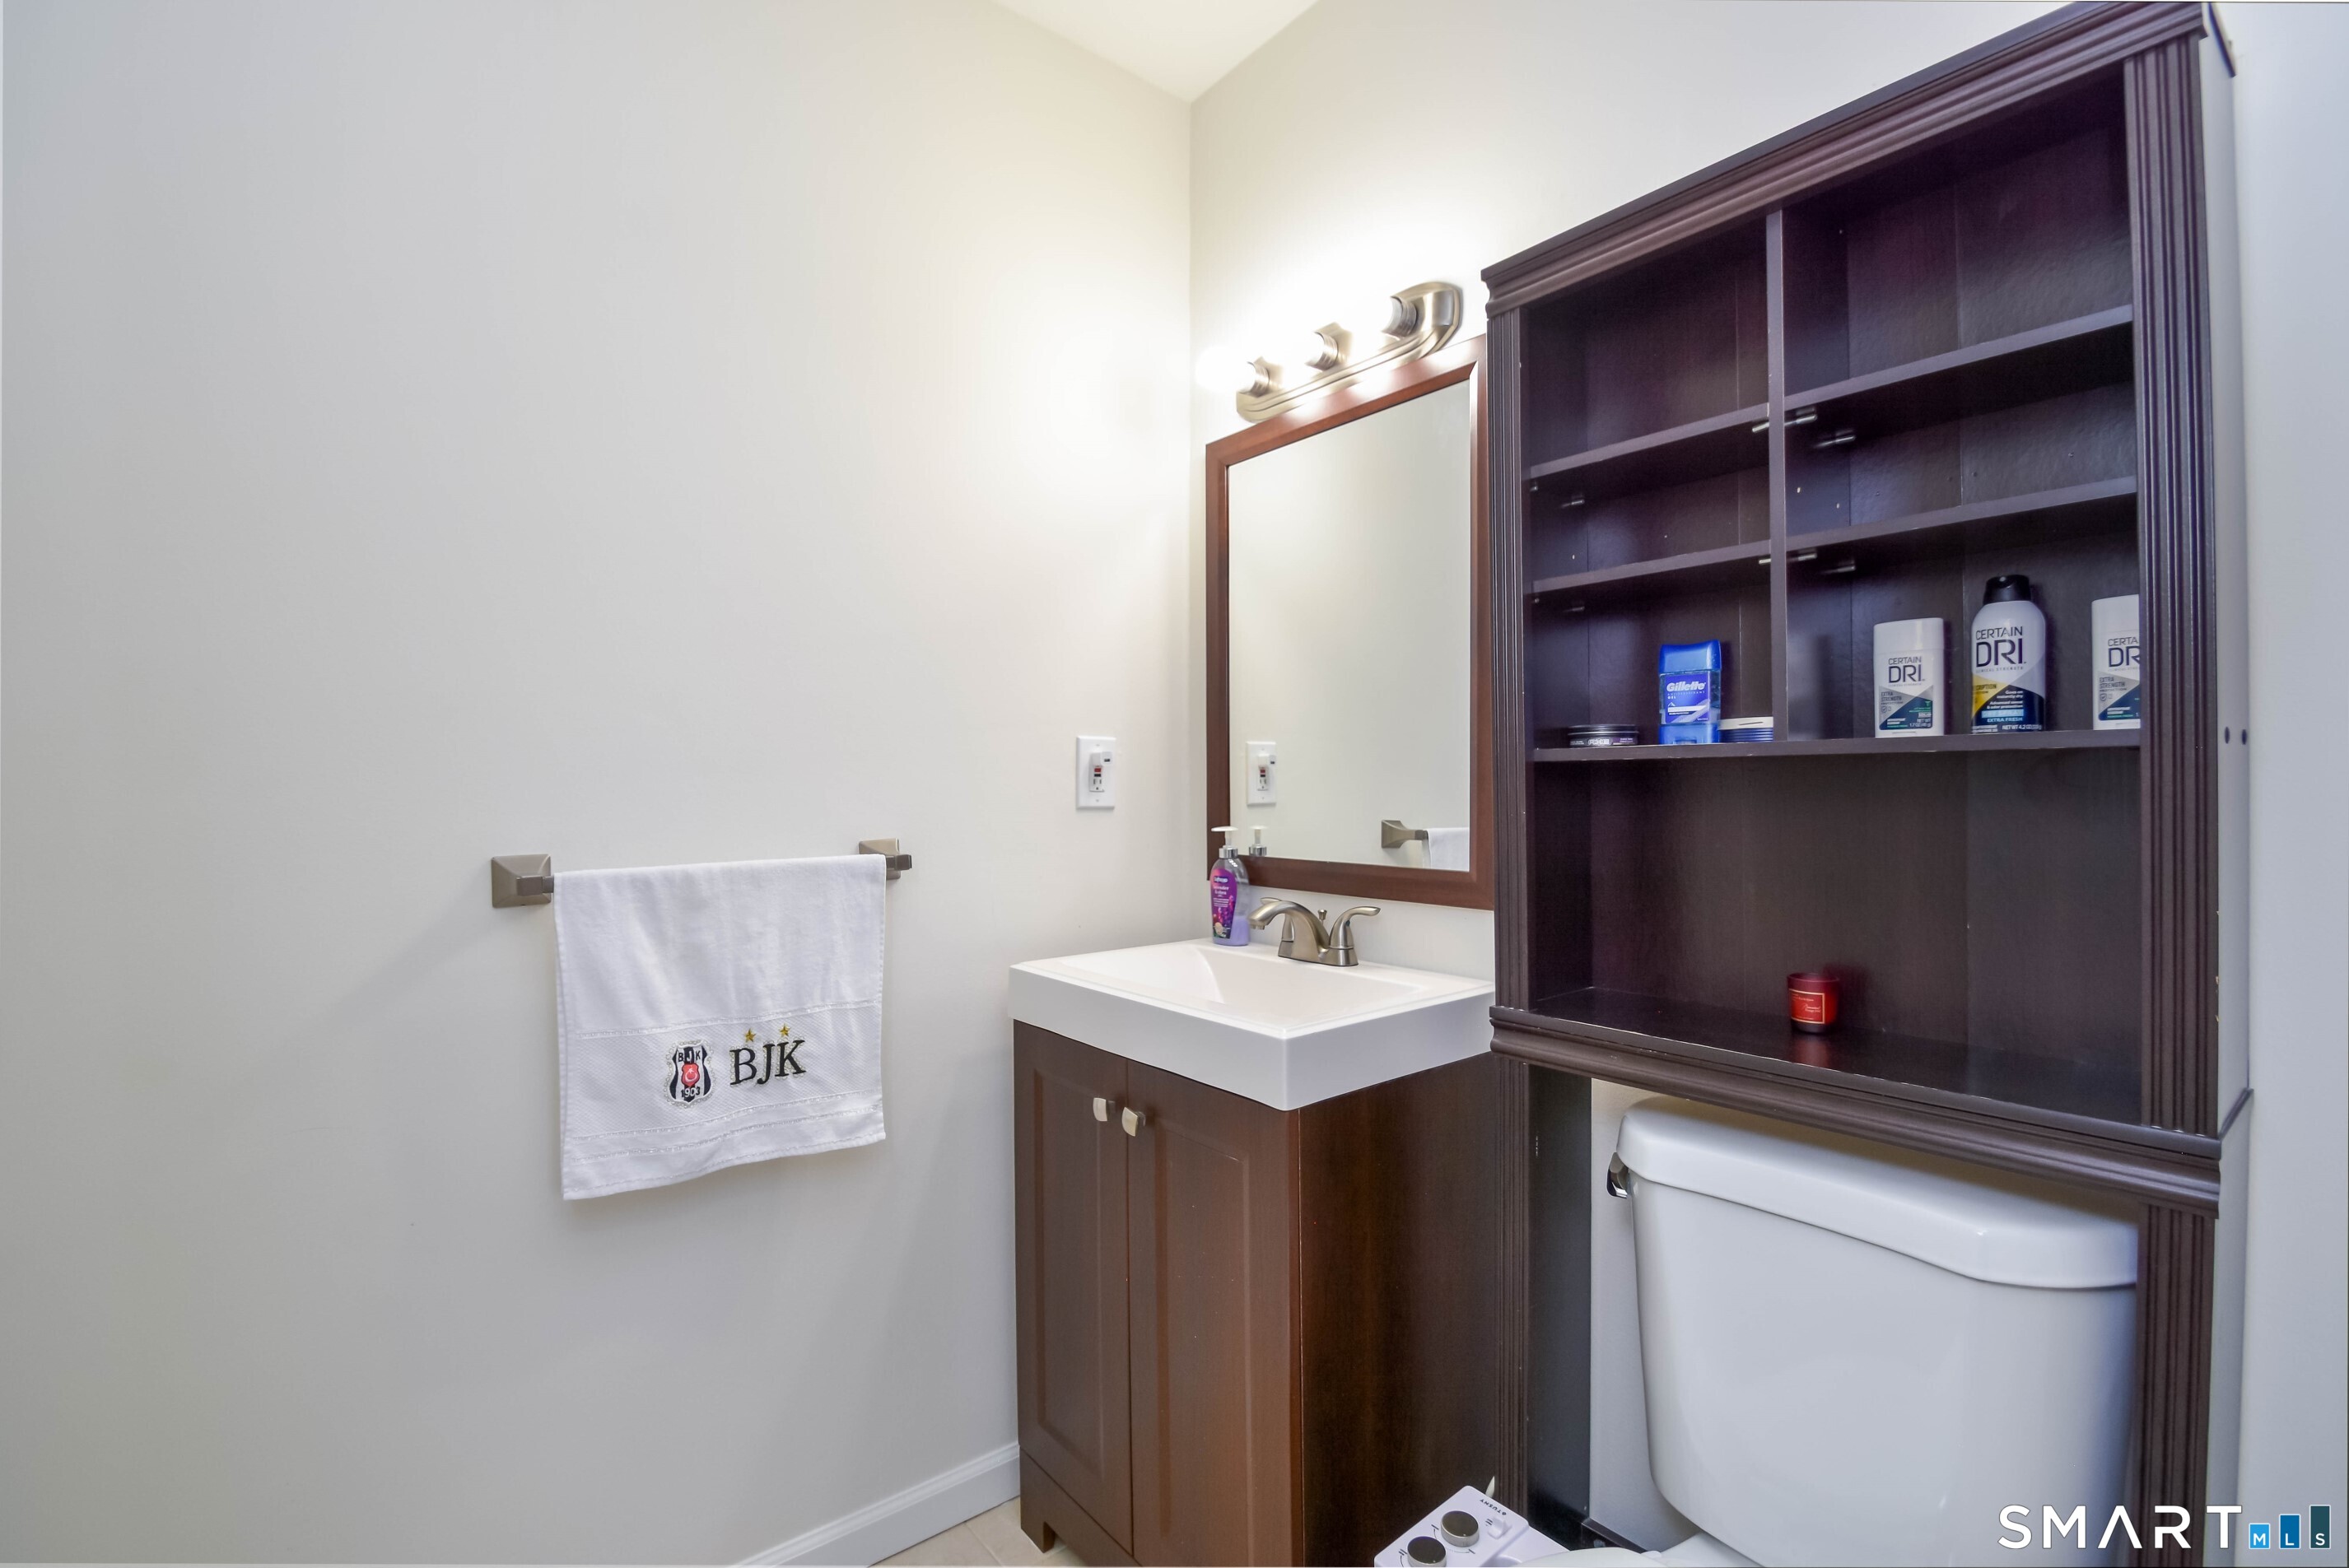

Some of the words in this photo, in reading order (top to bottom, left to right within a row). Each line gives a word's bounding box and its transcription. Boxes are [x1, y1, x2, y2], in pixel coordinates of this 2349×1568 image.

[1975, 626, 2024, 640] CERTAIN
[2108, 637, 2138, 647] CERTA
[1975, 639, 2023, 668] DRI
[2109, 646, 2140, 668] DR
[1888, 656, 1923, 666] CERTAIN
[1888, 664, 1922, 684] DRI
[1666, 681, 1706, 692] Gillette
[678, 1049, 701, 1063] BJK
[729, 1040, 807, 1086] BJK
[680, 1086, 701, 1099] 1903
